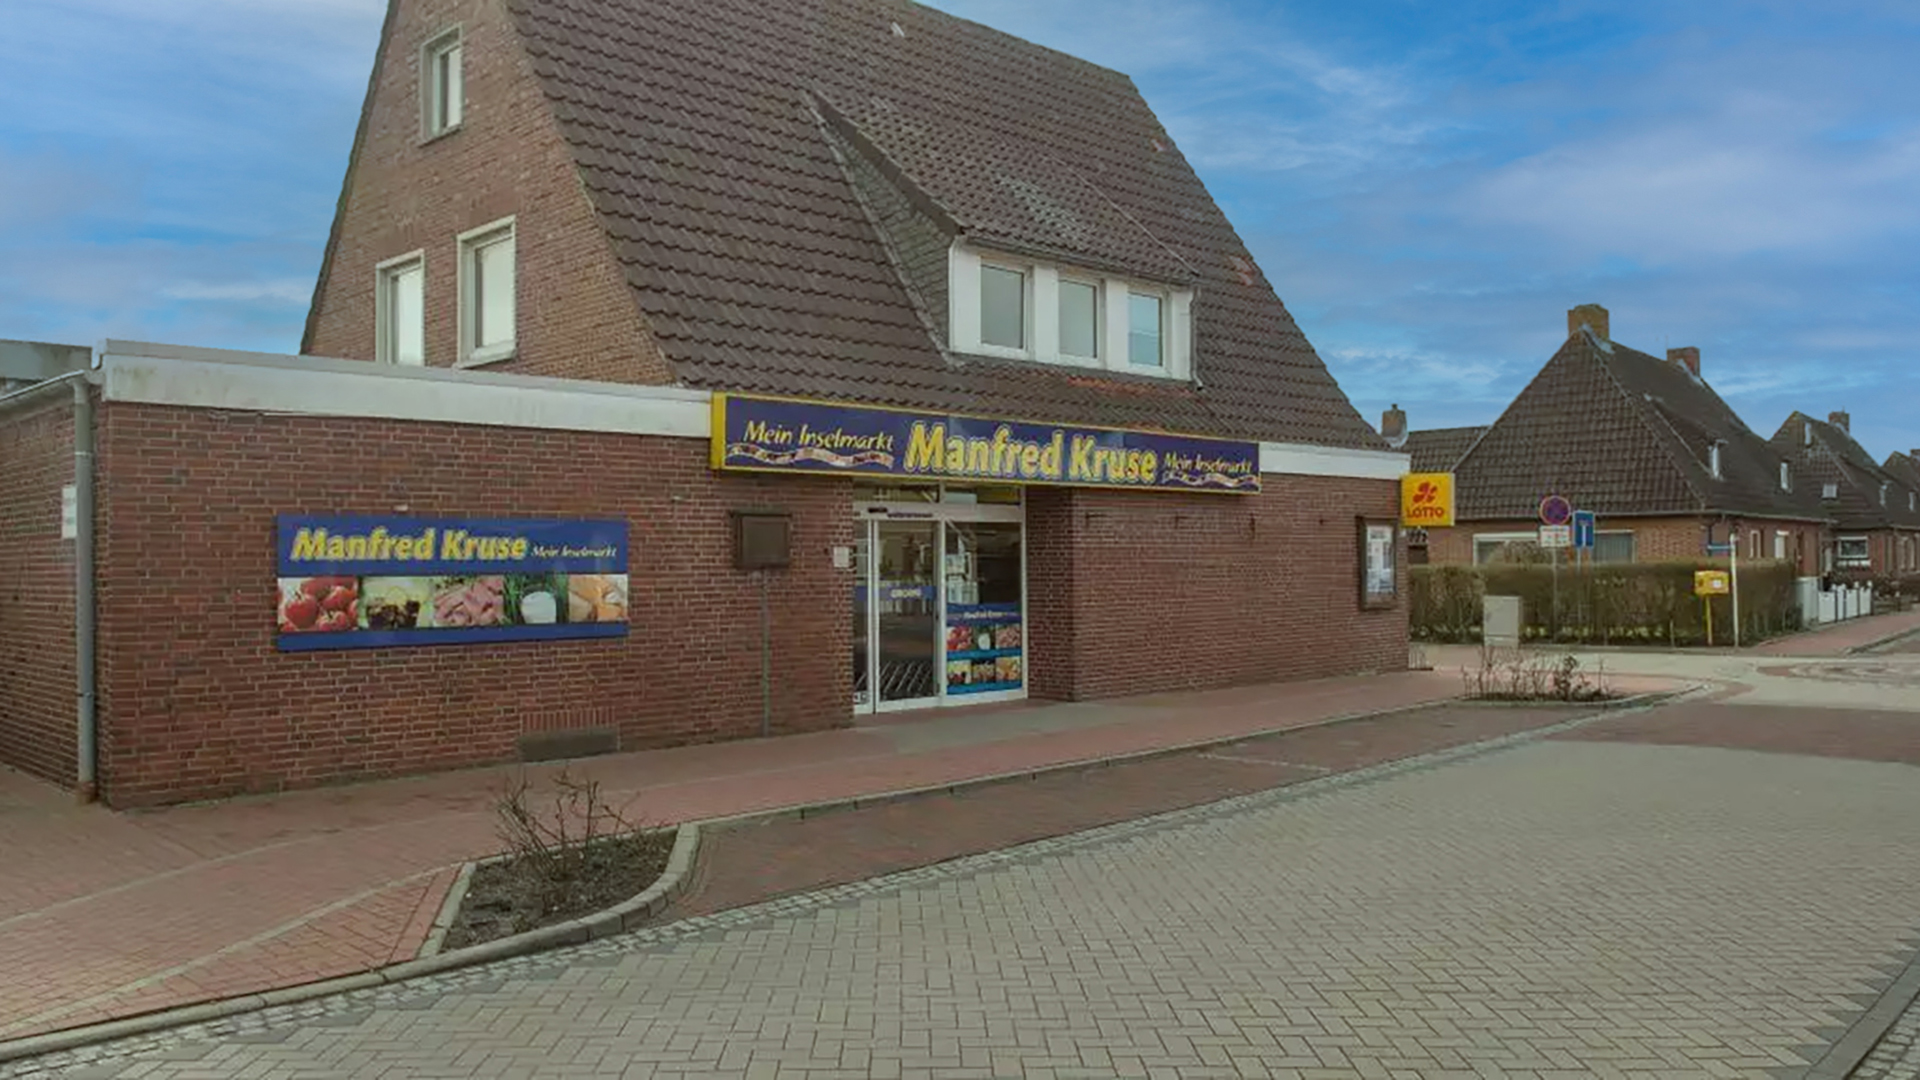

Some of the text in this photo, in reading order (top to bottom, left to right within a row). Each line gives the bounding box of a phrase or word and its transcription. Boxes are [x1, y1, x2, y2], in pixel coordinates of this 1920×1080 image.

[744, 420, 894, 451] Mein Inselmarkt
[904, 421, 1158, 483] Manfred Kruse
[1164, 452, 1192, 470] Mein
[1407, 507, 1445, 518] LOTTO
[291, 526, 527, 560] Manfred Kruse
